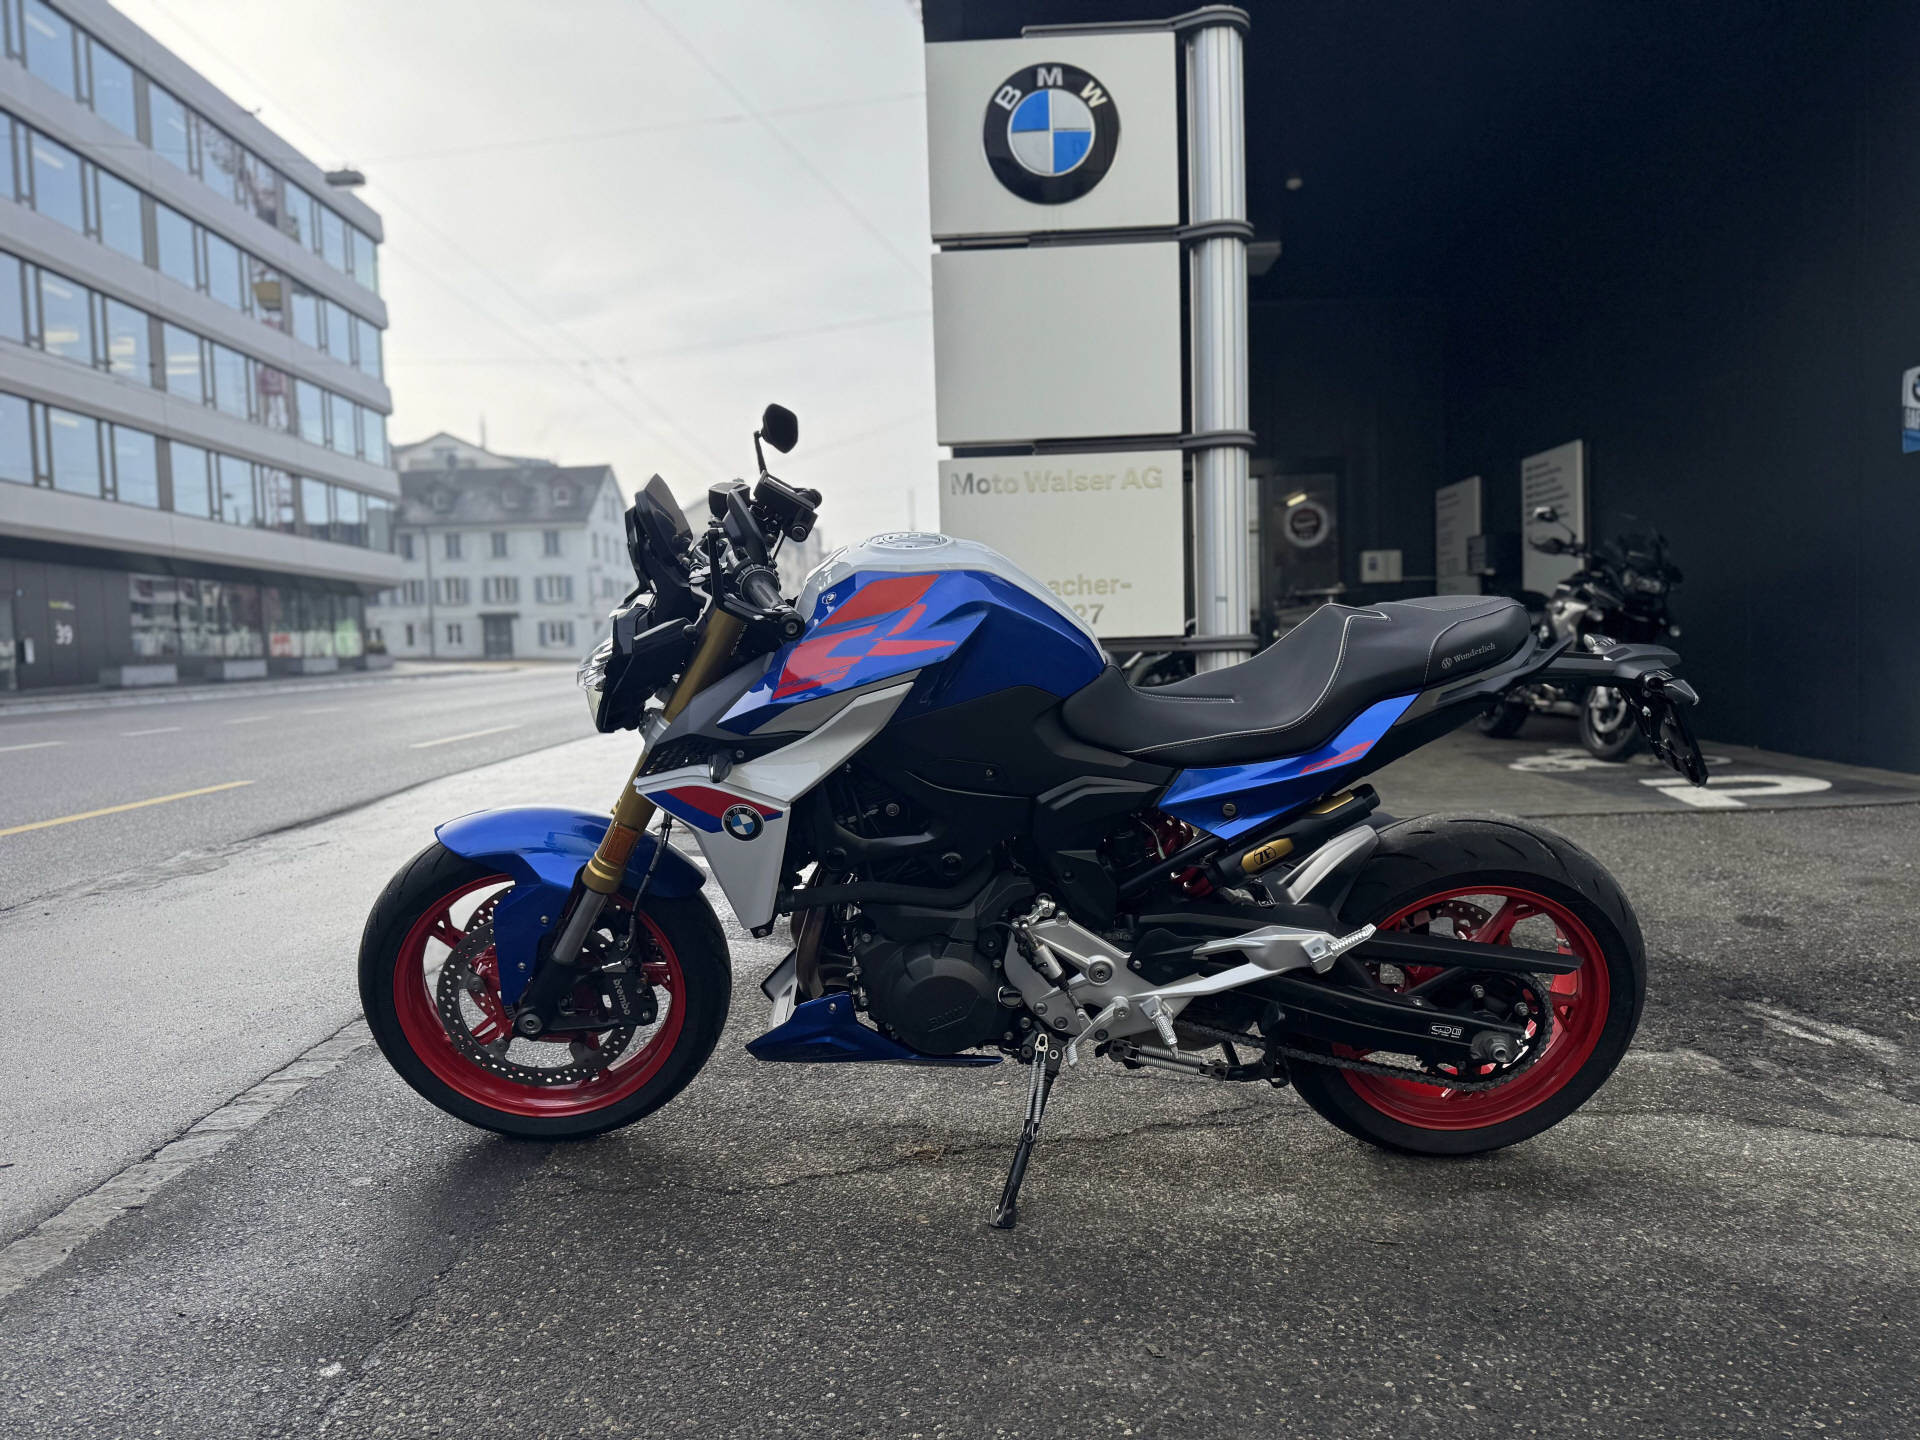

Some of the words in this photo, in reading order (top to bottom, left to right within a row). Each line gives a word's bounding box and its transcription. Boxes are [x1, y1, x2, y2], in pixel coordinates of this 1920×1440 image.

[994, 67, 1108, 111] BMW
[951, 472, 1018, 495] Moto
[1023, 469, 1115, 493] Walser
[1120, 466, 1163, 490] AG
[1047, 574, 1133, 596] acher-
[1453, 642, 1496, 663] Wunderlich
[725, 807, 755, 822] BMW
[613, 978, 631, 1016] brembo
